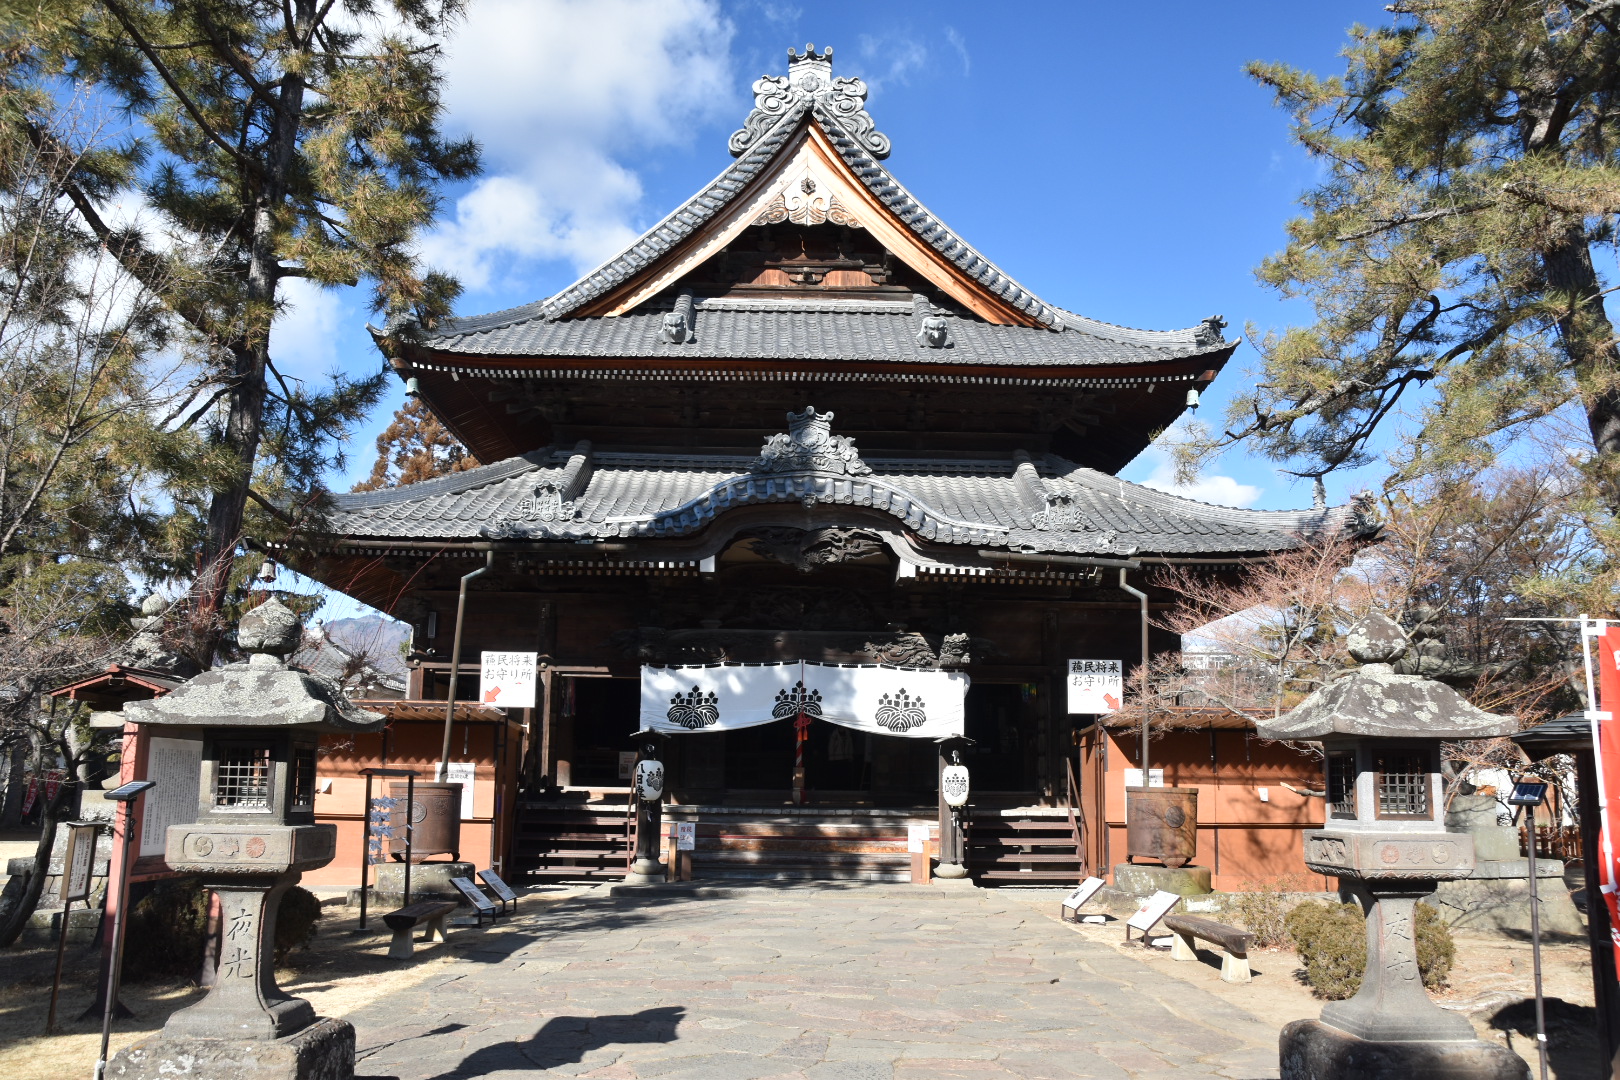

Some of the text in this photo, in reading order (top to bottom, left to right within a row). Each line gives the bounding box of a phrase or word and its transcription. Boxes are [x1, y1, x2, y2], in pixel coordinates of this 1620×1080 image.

[485, 668, 532, 681] お守り所
[1072, 674, 1120, 687] お守り所
[636, 763, 647, 799] 八日堂
[225, 908, 255, 979] 夜光
[1385, 912, 1415, 981] 夜光
